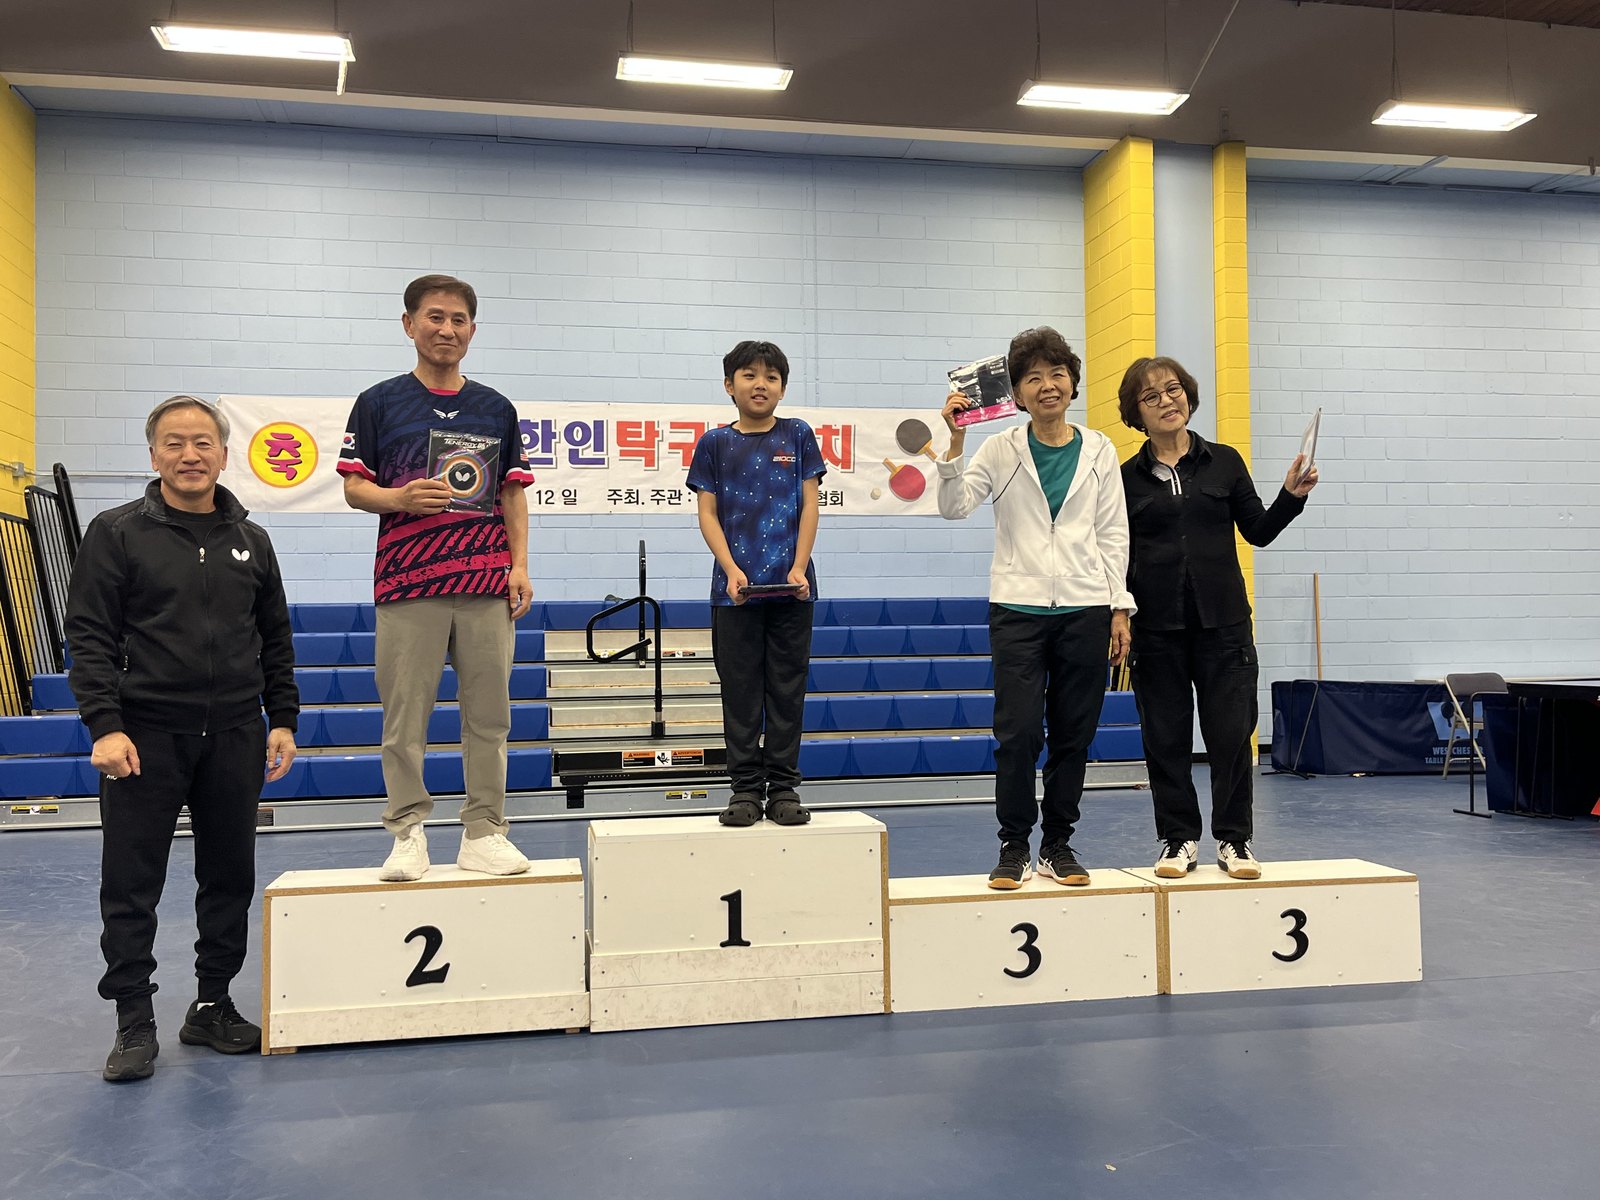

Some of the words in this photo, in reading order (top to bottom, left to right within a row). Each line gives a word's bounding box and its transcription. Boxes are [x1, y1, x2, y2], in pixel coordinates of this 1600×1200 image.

[264, 432, 303, 481] 축
[535, 489, 555, 505] 12
[561, 489, 577, 505] 일
[719, 889, 751, 947] 1
[1272, 908, 1310, 962] 3
[404, 924, 450, 987] 2
[1003, 922, 1042, 979] 3
